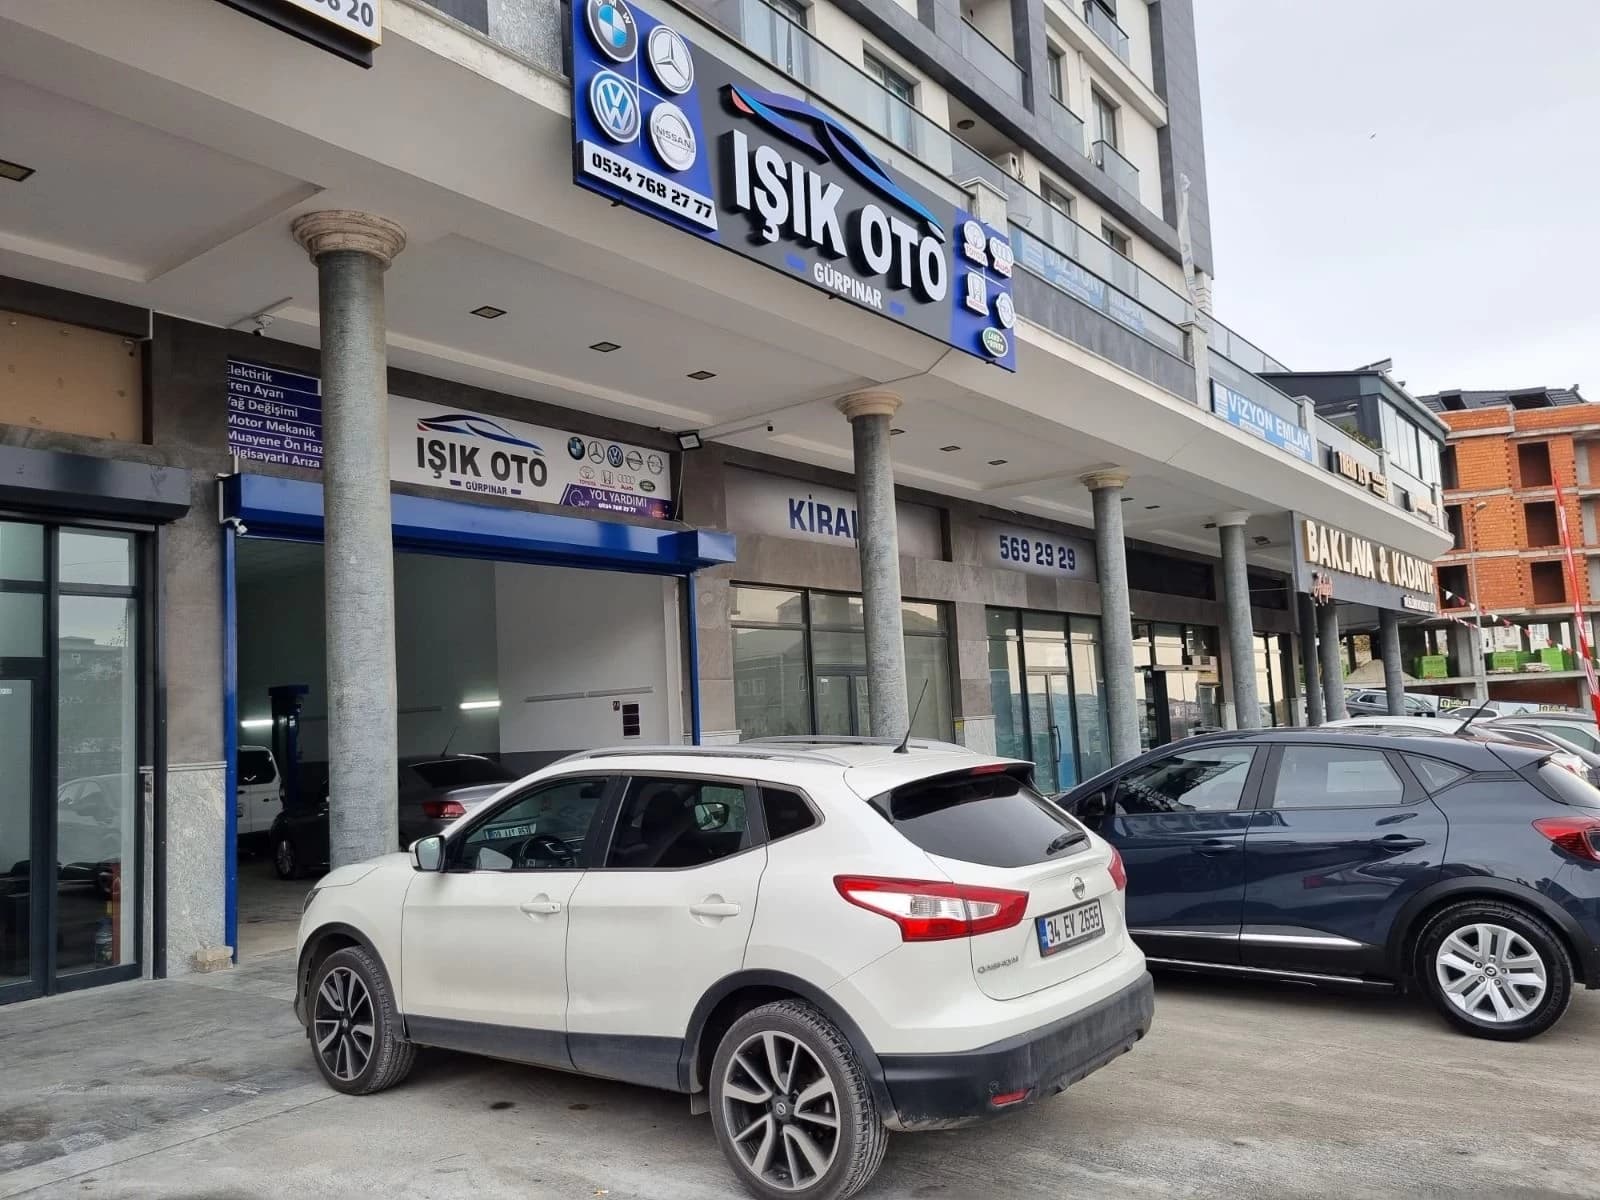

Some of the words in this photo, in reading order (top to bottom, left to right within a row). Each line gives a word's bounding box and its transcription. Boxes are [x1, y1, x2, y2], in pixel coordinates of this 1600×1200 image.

[656, 125, 692, 150] NISSAN
[592, 152, 633, 183] 0534
[636, 172, 667, 199] 768
[671, 189, 690, 208] 27
[694, 199, 713, 218] 77
[731, 129, 847, 257] IŞIK
[860, 204, 948, 302] OTO
[813, 263, 883, 309] GÜRPINAR
[228, 364, 273, 382] lektirik
[228, 381, 251, 393] ren
[253, 385, 285, 399] Ayarı
[248, 400, 299, 418] Değişimi
[228, 414, 264, 428] Motor
[266, 420, 317, 438] Mekanik
[1276, 417, 1312, 453] EMLAK
[228, 430, 281, 447] Muayene
[284, 436, 301, 450] Ön
[291, 455, 320, 468] Arıza
[417, 437, 482, 479] IŞIK
[490, 451, 548, 487] OTO
[465, 481, 508, 495] GÜRPINAR
[589, 488, 608, 502] YOL
[609, 491, 647, 508] YARDIMI
[999, 534, 1031, 563] 569
[1035, 541, 1054, 567] 29
[1058, 546, 1077, 571] 29
[1305, 519, 1377, 580] BAKLAVA
[1379, 545, 1391, 583] &
[1047, 918, 1061, 944] 34
[1063, 912, 1075, 939] EV
[1078, 905, 1100, 933] 2655
